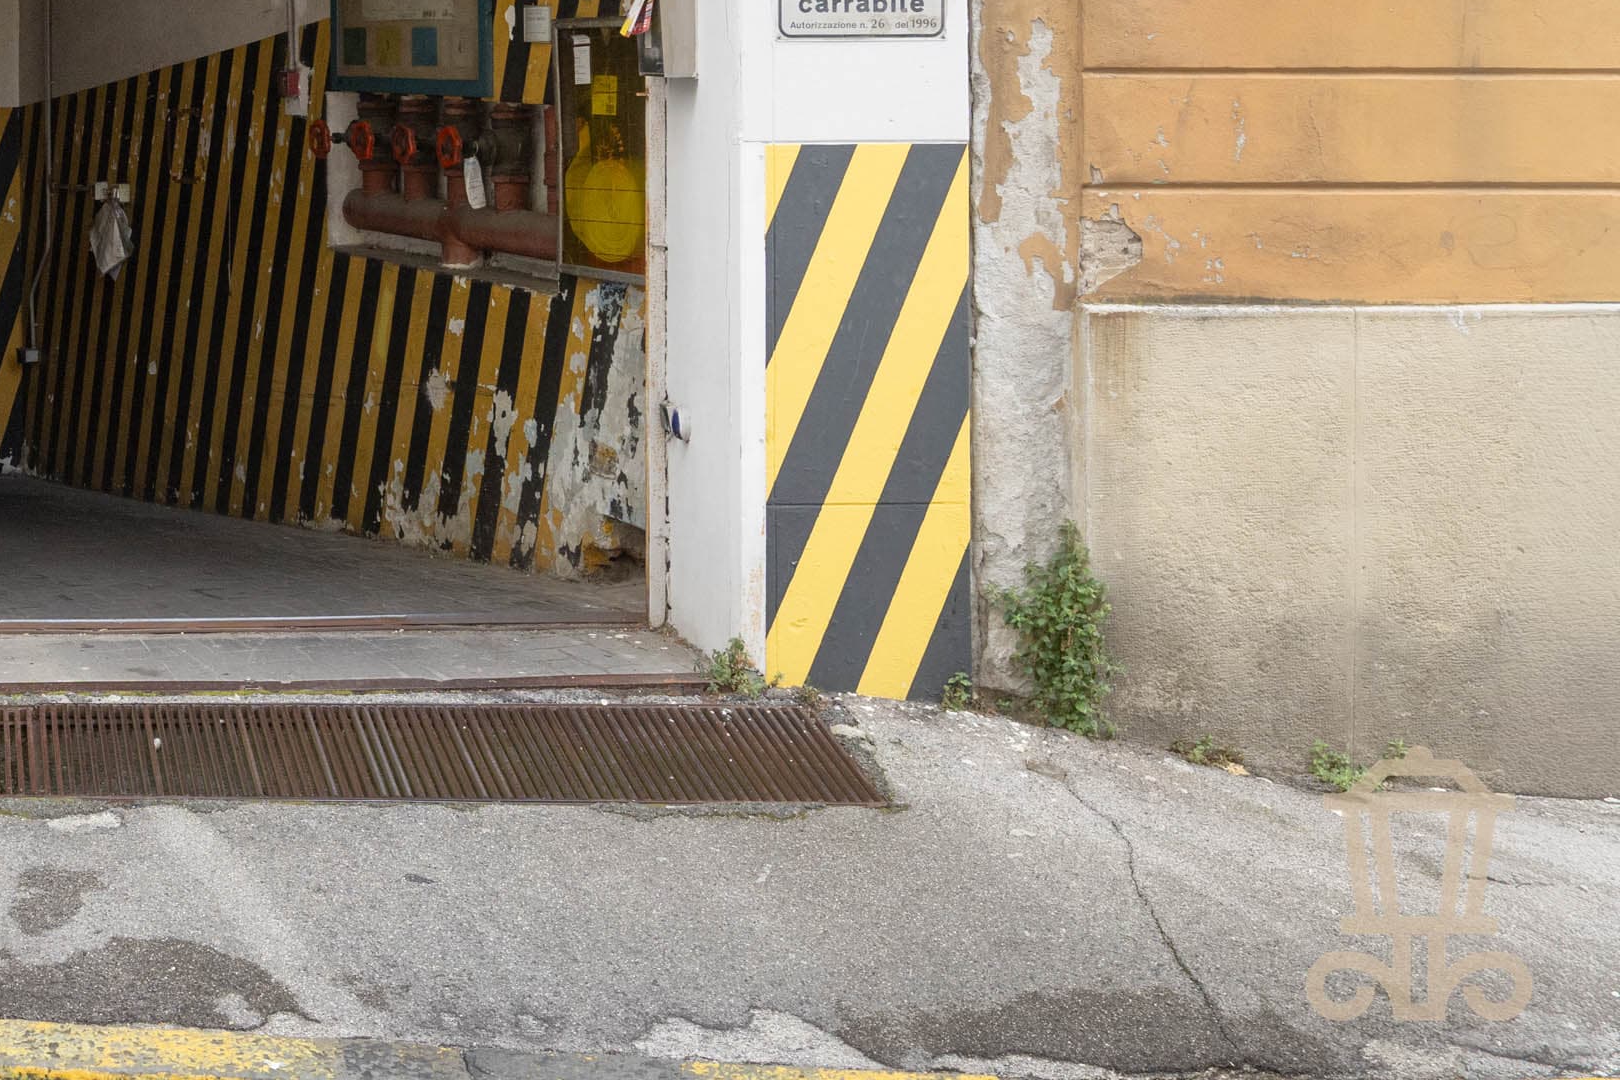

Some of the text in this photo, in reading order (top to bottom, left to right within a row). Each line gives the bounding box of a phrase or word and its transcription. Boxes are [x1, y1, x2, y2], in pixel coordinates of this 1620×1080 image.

[790, 18, 938, 30] Autorizzazione n. 26 del 1996
